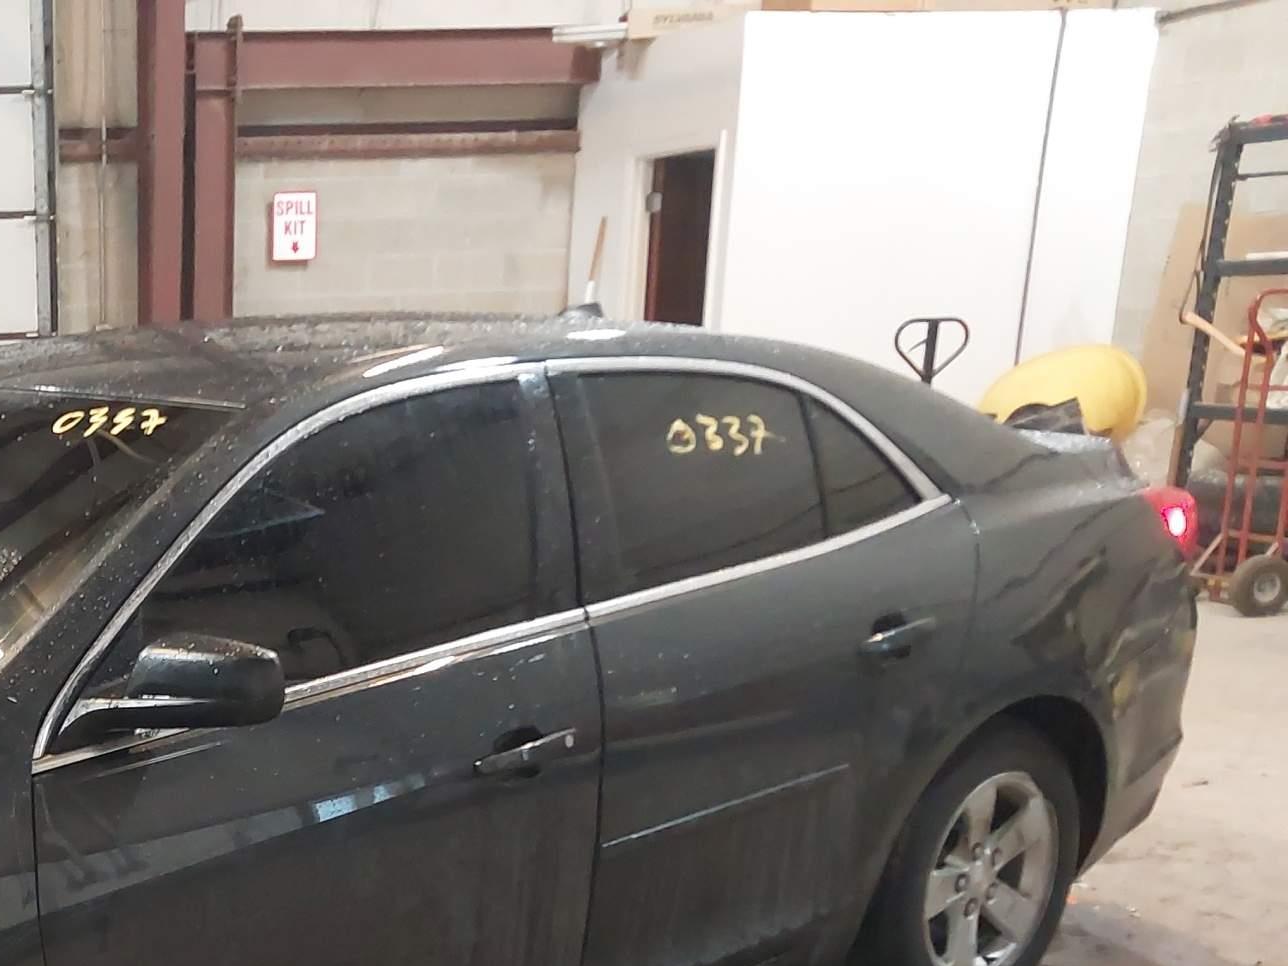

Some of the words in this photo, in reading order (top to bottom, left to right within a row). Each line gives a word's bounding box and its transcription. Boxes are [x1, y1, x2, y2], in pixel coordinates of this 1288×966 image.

[276, 199, 313, 216] SPILL
[284, 219, 306, 236] KIT
[666, 413, 780, 456] 0337
